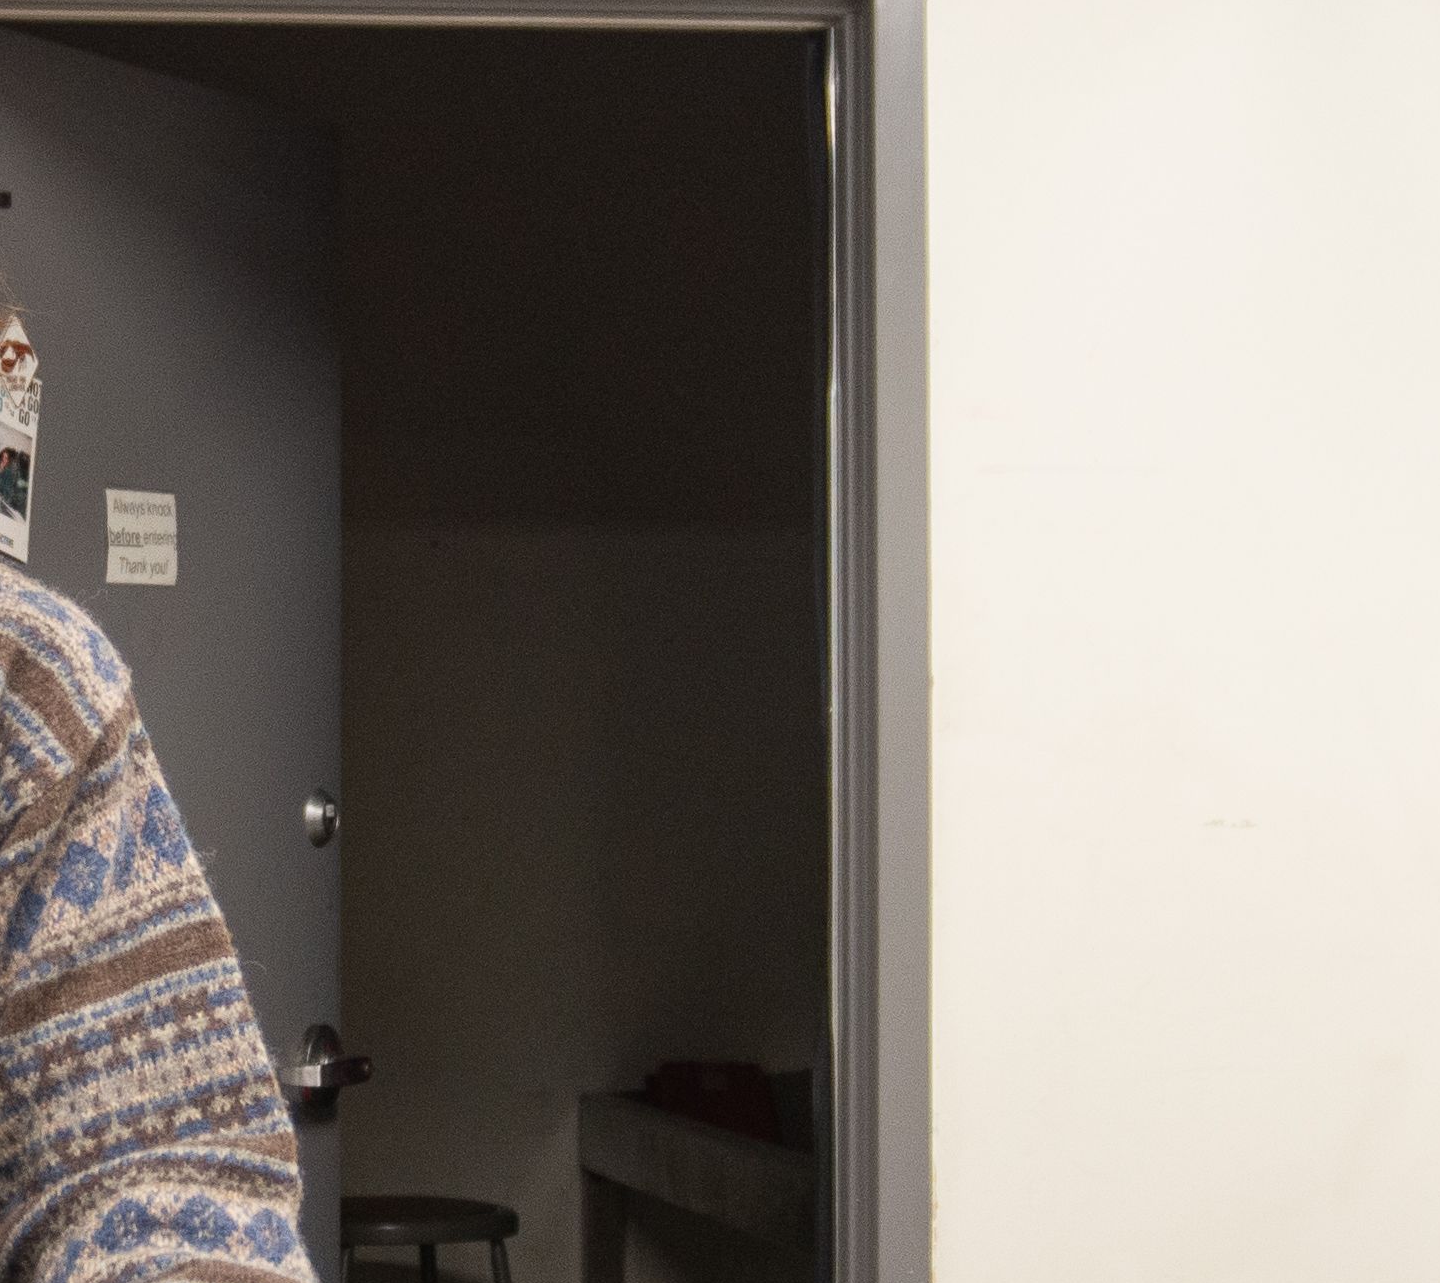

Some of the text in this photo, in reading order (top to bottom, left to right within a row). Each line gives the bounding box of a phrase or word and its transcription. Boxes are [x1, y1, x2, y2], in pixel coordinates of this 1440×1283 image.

[112, 498, 173, 519] Always knock
[108, 527, 143, 547] before
[119, 556, 148, 575] Thank
